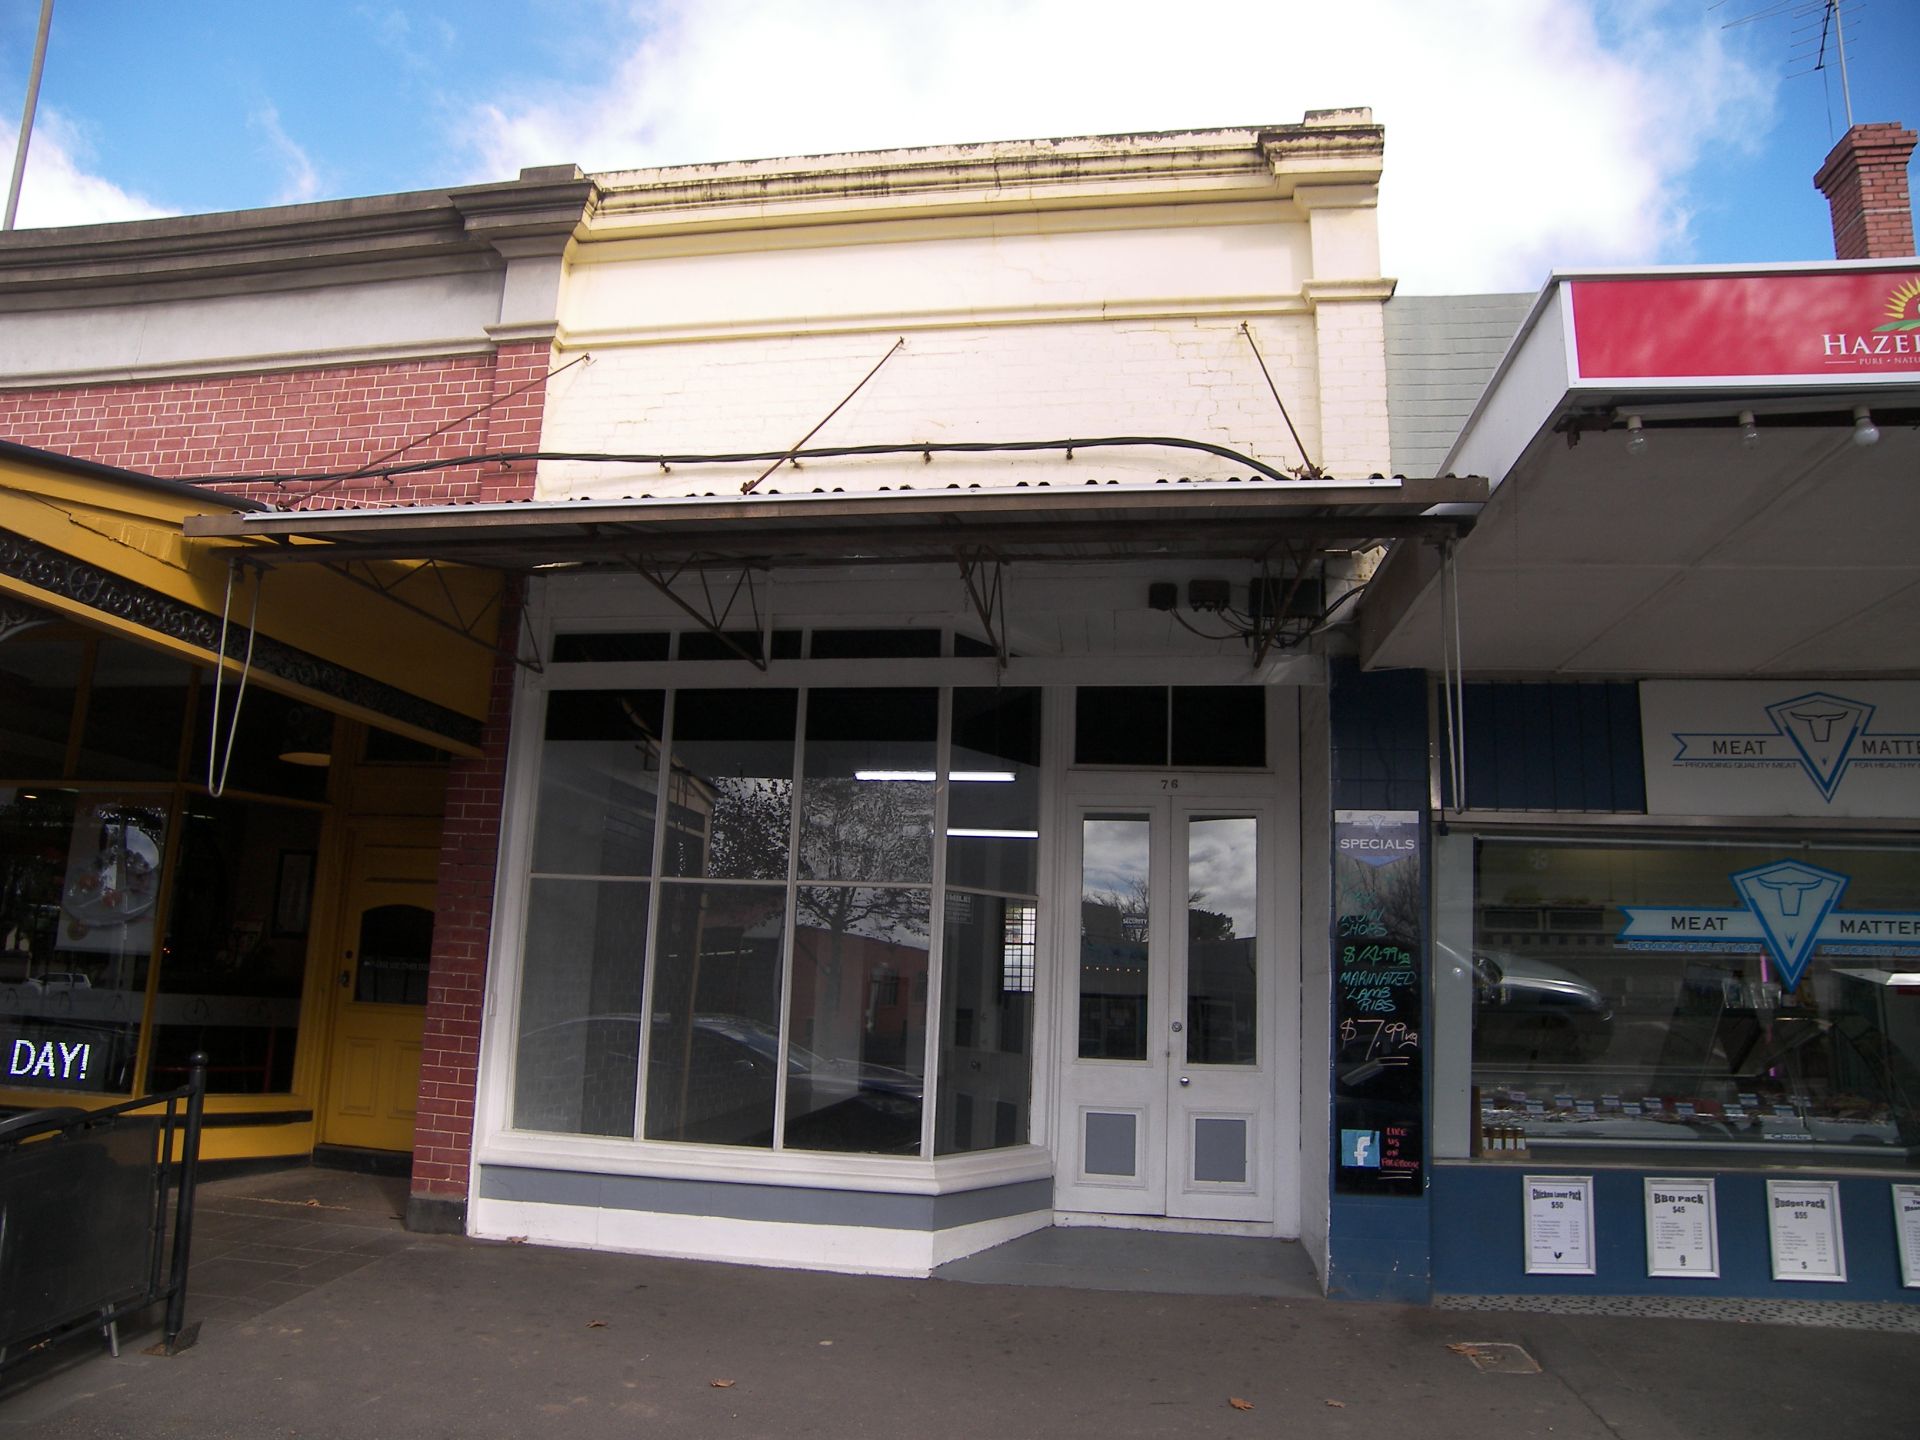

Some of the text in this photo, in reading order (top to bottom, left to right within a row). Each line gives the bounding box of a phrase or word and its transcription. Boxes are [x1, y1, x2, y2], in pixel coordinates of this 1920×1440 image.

[1713, 740, 1767, 755] MEAT
[1161, 779, 1178, 789] 76
[1340, 839, 1415, 850] SPECIALS
[1671, 916, 1728, 931] MEAT
[1339, 971, 1416, 986] MARINATED
[1347, 987, 1391, 1000] LAMB
[1357, 1000, 1396, 1012] RIBS
[10, 1039, 90, 1079] DAY!
[1386, 1127, 1407, 1136] LIKE
[1569, 1190, 1582, 1201] Pack
[1654, 1193, 1675, 1204] BBQ
[1551, 1201, 1564, 1209] $50
[1774, 1197, 1803, 1208] Budget
[1672, 1206, 1685, 1214] $45
[1794, 1211, 1808, 1219] $55
